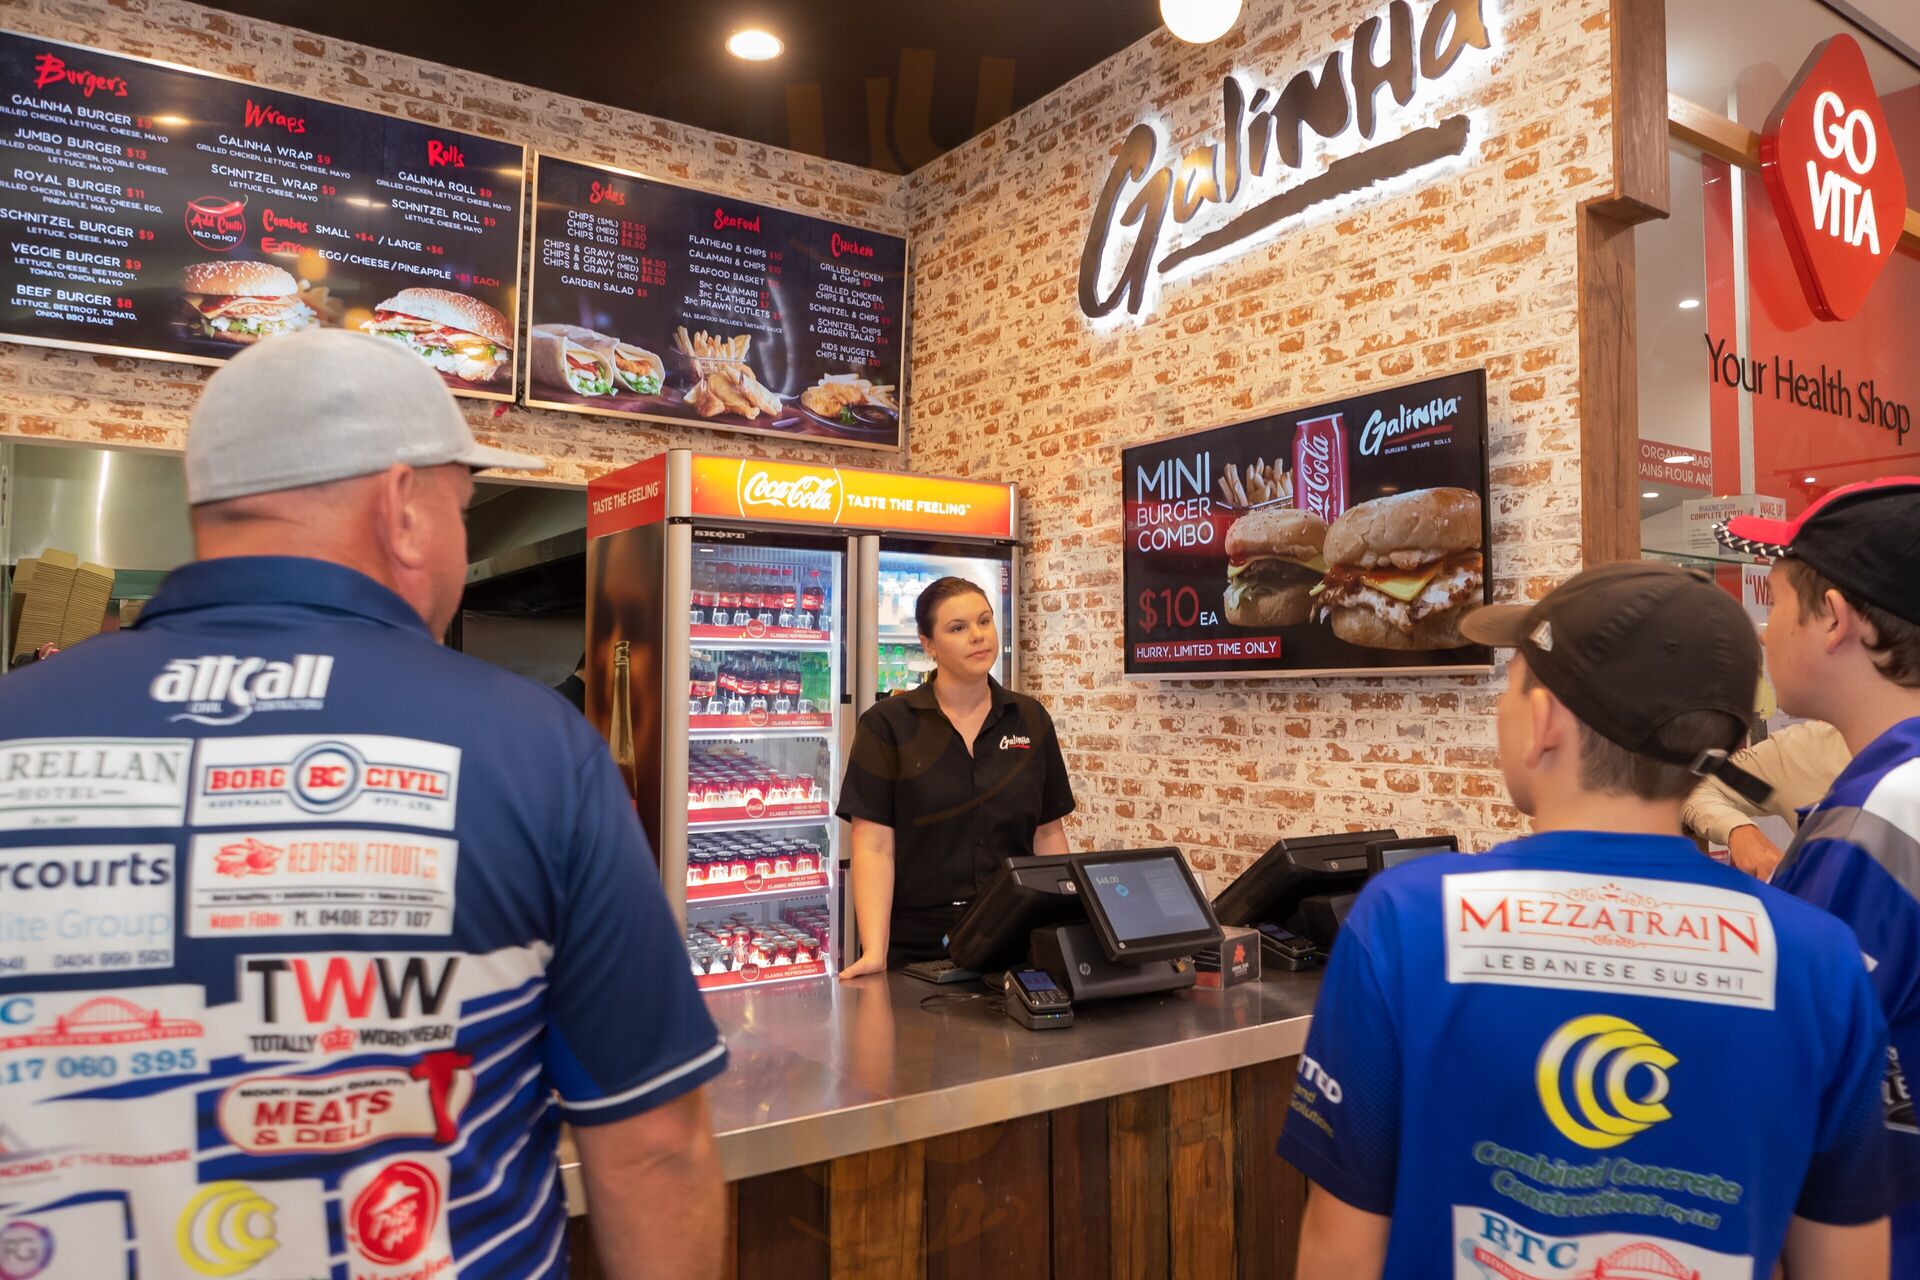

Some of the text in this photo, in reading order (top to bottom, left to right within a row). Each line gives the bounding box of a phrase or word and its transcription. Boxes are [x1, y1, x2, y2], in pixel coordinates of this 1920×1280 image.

[34, 53, 128, 97] Burgers
[11, 94, 73, 115] GALINHA
[77, 106, 132, 126] BURGER
[244, 98, 306, 133] Wraps
[14, 128, 63, 145] JUMBO
[66, 136, 122, 156] BURGER
[1813, 91, 1876, 174] GO
[218, 134, 332, 165] GALINHA WRAP $9
[427, 140, 465, 168] Rolls
[13, 168, 145, 199] ROYAL BURGER $11
[211, 163, 336, 196] SCHNITZEL WRAP $9
[398, 171, 445, 189] GALINHA
[448, 181, 476, 196] ROLL
[589, 180, 625, 206] Sides
[391, 198, 496, 227] SCHNITZEL ROLL $9
[568, 210, 619, 228] CHIPS (SML)
[1806, 160, 1880, 254] VITA
[0, 208, 155, 241] SCHNITZEL BURGER $9
[262, 208, 309, 234] Combos
[315, 225, 351, 239] SMALL
[387, 238, 422, 252] LARGE
[567, 219, 619, 237] CHIPS (MED)
[567, 228, 618, 246] CHIPS (LRG)
[221, 234, 237, 243] HOT
[543, 239, 638, 264] CHIPS GRAVY (SML)
[689, 235, 767, 258] FLATHEAD CHIPS
[11, 242, 142, 270] VEGGIE BURGER $9
[543, 248, 639, 273] CHIPS GRAVY (MED)
[543, 257, 638, 281] CHIPS GRAVY (LRG)
[689, 249, 766, 272] CALAMARI CHIPS
[473, 276, 500, 287] EACH
[561, 275, 601, 290] GARDEN
[603, 283, 634, 295] SALAD
[689, 264, 731, 279] SEAFOOD
[733, 272, 765, 285] BASKET
[820, 262, 884, 283] GRILLED CHICKEN
[16, 284, 52, 298] BEEF
[56, 289, 112, 307] BURGER
[809, 302, 849, 318] SCHNITZEL
[821, 342, 838, 352] KIDS
[1704, 333, 1910, 446] Your Health Shop
[1384, 437, 1452, 455] BURGERS WRAPS ROLLS
[1137, 451, 1210, 504] MINI
[1665, 467, 1694, 483] FLOUR
[593, 499, 613, 515] TASTE
[613, 494, 628, 509] THE
[744, 472, 837, 510] Coca-Cola
[847, 495, 886, 509] TASTE
[889, 498, 913, 511] THE
[1137, 497, 1211, 528] BURGER
[1690, 511, 1722, 521] COMPLETE
[1760, 501, 1784, 516] WAKE UP
[1137, 520, 1214, 552] COMBO
[1138, 586, 1218, 633] $10 EA
[1136, 641, 1276, 659] HURRY, LIMITED TIME ONLY
[17, 786, 97, 800] HOTEL
[210, 766, 444, 795] BORG BC CIVIL
[287, 841, 358, 874] REDFISH
[364, 843, 421, 877] FITOUT
[59, 908, 171, 943] Group
[368, 911, 398, 926] 237
[406, 911, 433, 927] 107
[1460, 896, 1760, 956] MEZZATRAIN
[1483, 954, 1744, 990] LEBANESE SUSHI
[247, 957, 461, 1024] TWW
[251, 1033, 318, 1054] TOTALLY
[131, 1049, 197, 1076] 395
[254, 1090, 393, 1126] MEATS
[254, 1120, 372, 1145] & DELI
[1472, 1140, 1743, 1204] Combined Concrete
[1491, 1169, 1665, 1216] Constructions
[1480, 1213, 1579, 1270] RTC
